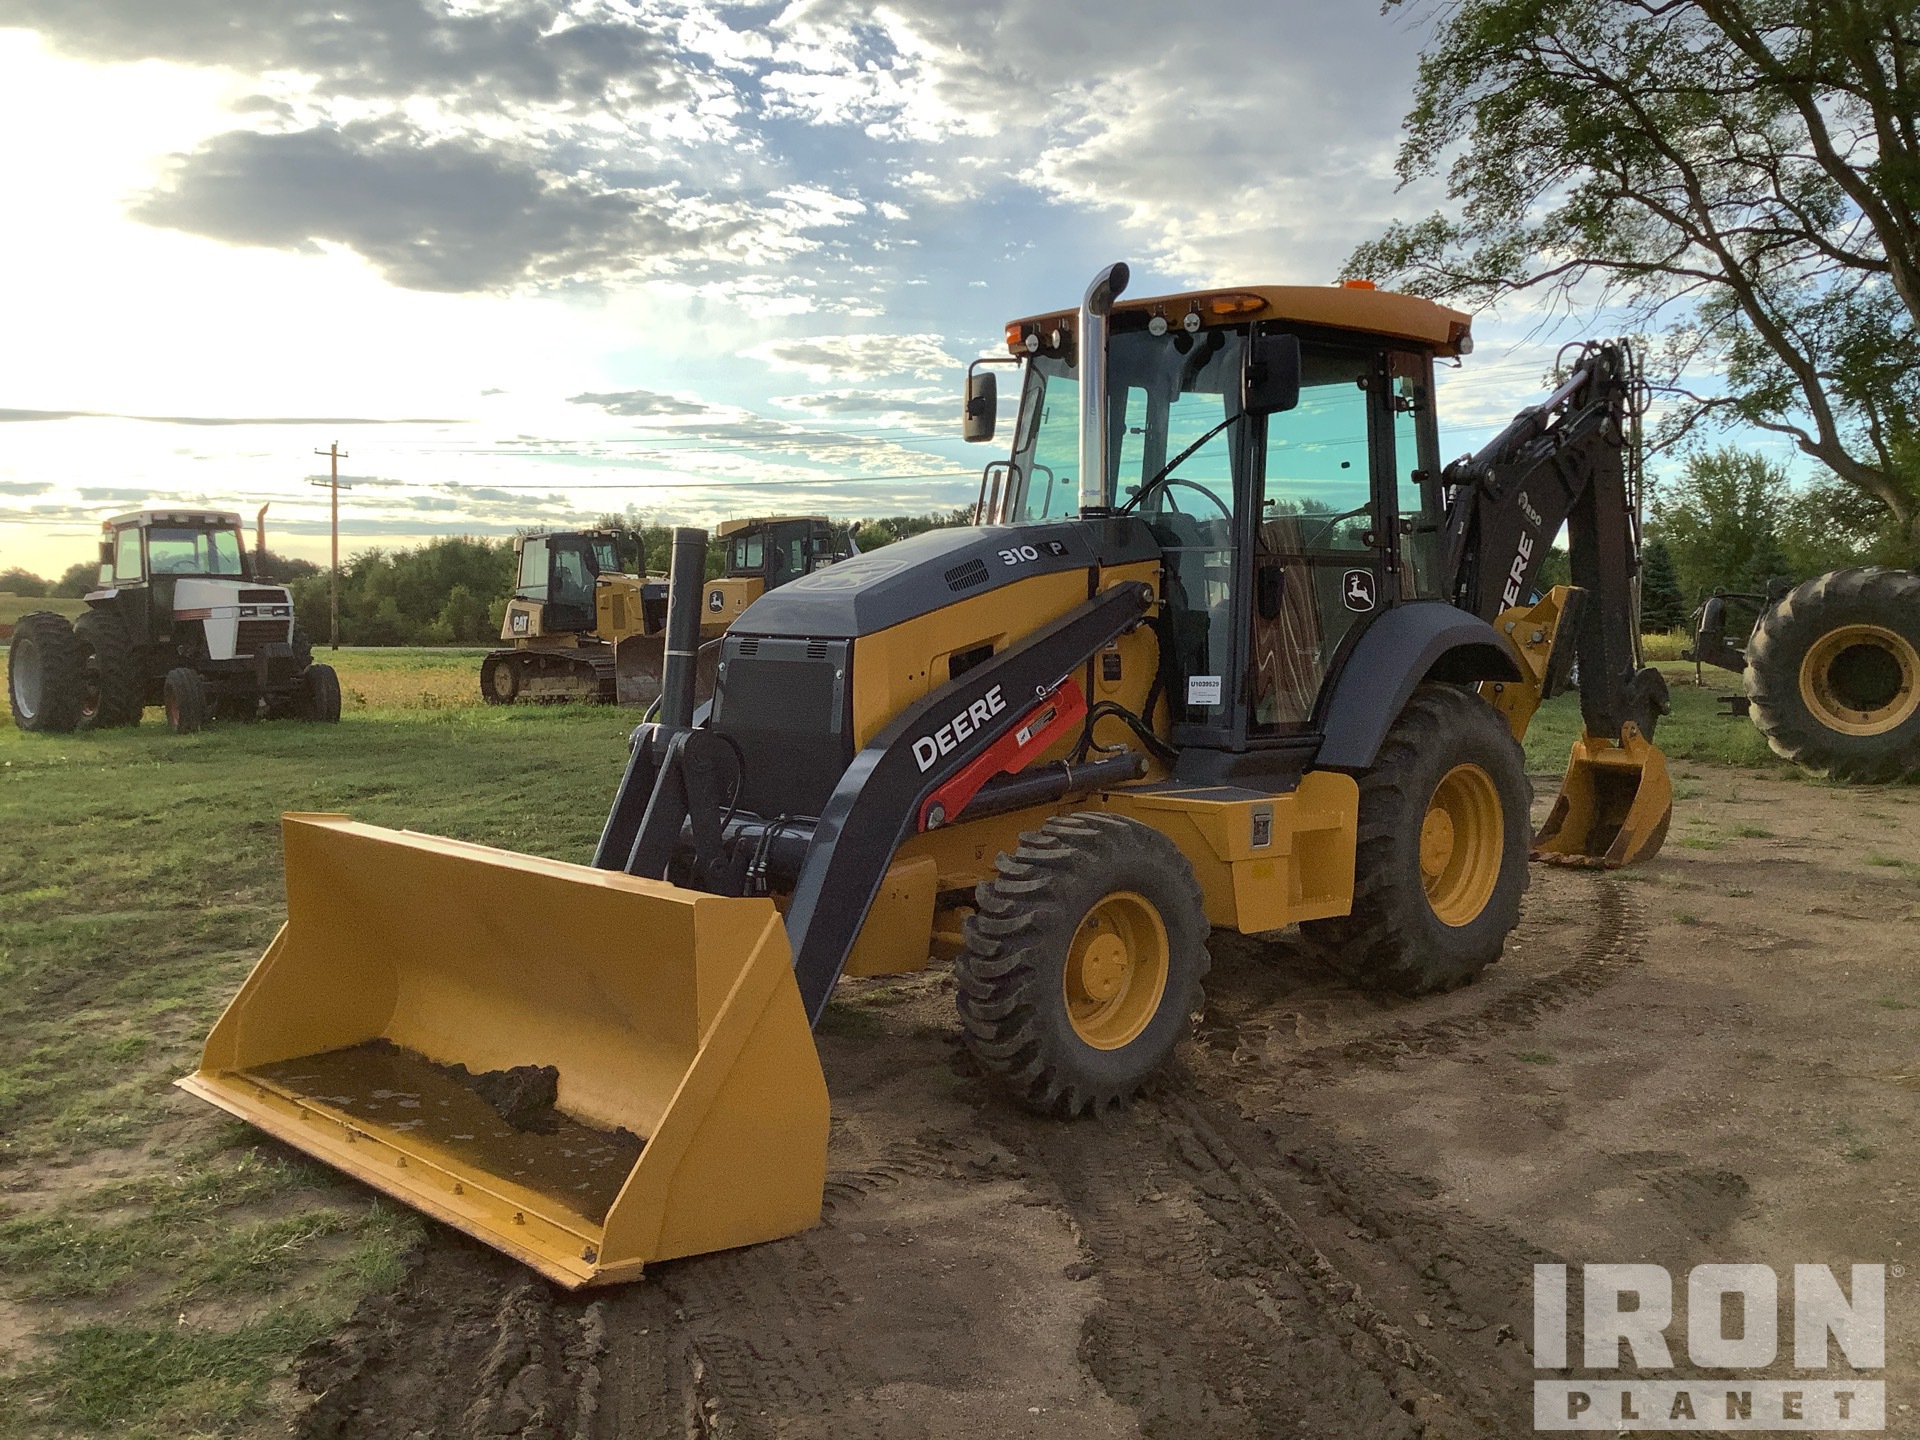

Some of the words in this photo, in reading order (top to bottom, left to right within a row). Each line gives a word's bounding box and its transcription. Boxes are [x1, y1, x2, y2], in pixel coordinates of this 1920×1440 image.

[998, 545, 1038, 566] 310
[1050, 542, 1062, 555] P
[1498, 531, 1534, 615] ERE
[514, 615, 528, 632] CAT
[911, 684, 1007, 773] DEERE
